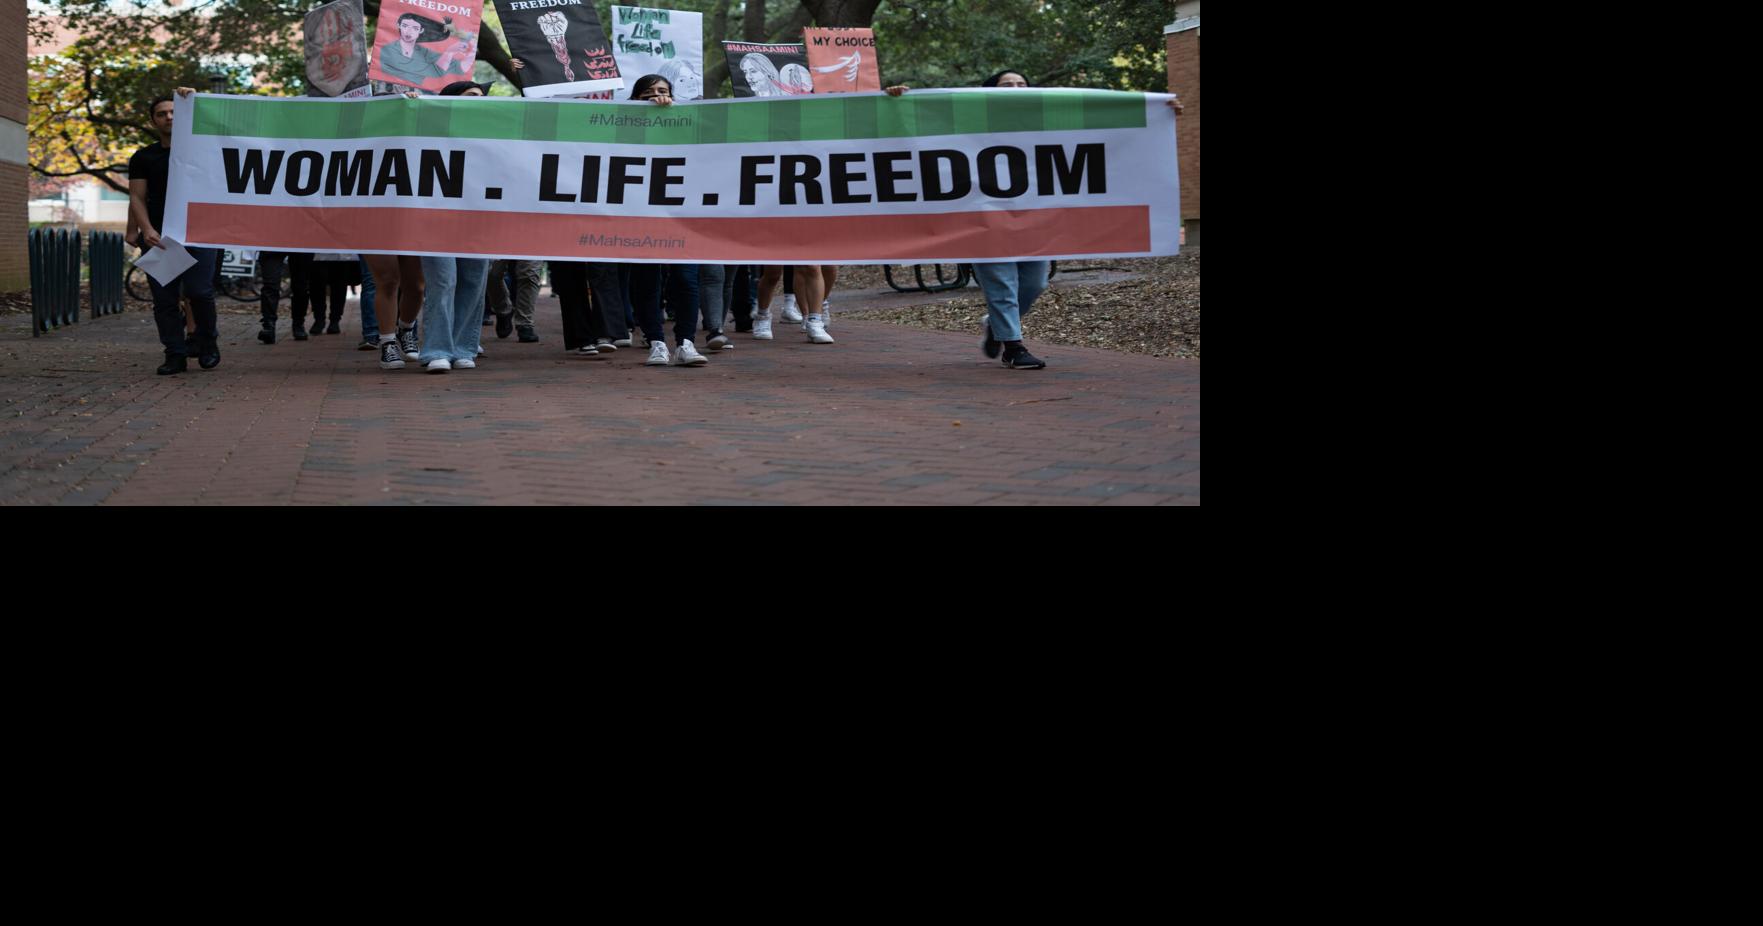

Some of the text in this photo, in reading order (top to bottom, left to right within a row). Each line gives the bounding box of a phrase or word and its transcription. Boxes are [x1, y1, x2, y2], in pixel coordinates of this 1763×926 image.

[726, 43, 799, 55] #MAHSAAMINI
[813, 36, 876, 47] MY CHOICE
[589, 113, 692, 128] #MahsaAmini
[222, 147, 466, 198] WOMAN
[538, 153, 686, 206] LIFE
[739, 143, 1107, 206] FREEDOM
[577, 232, 685, 248] #MahsaAmini
